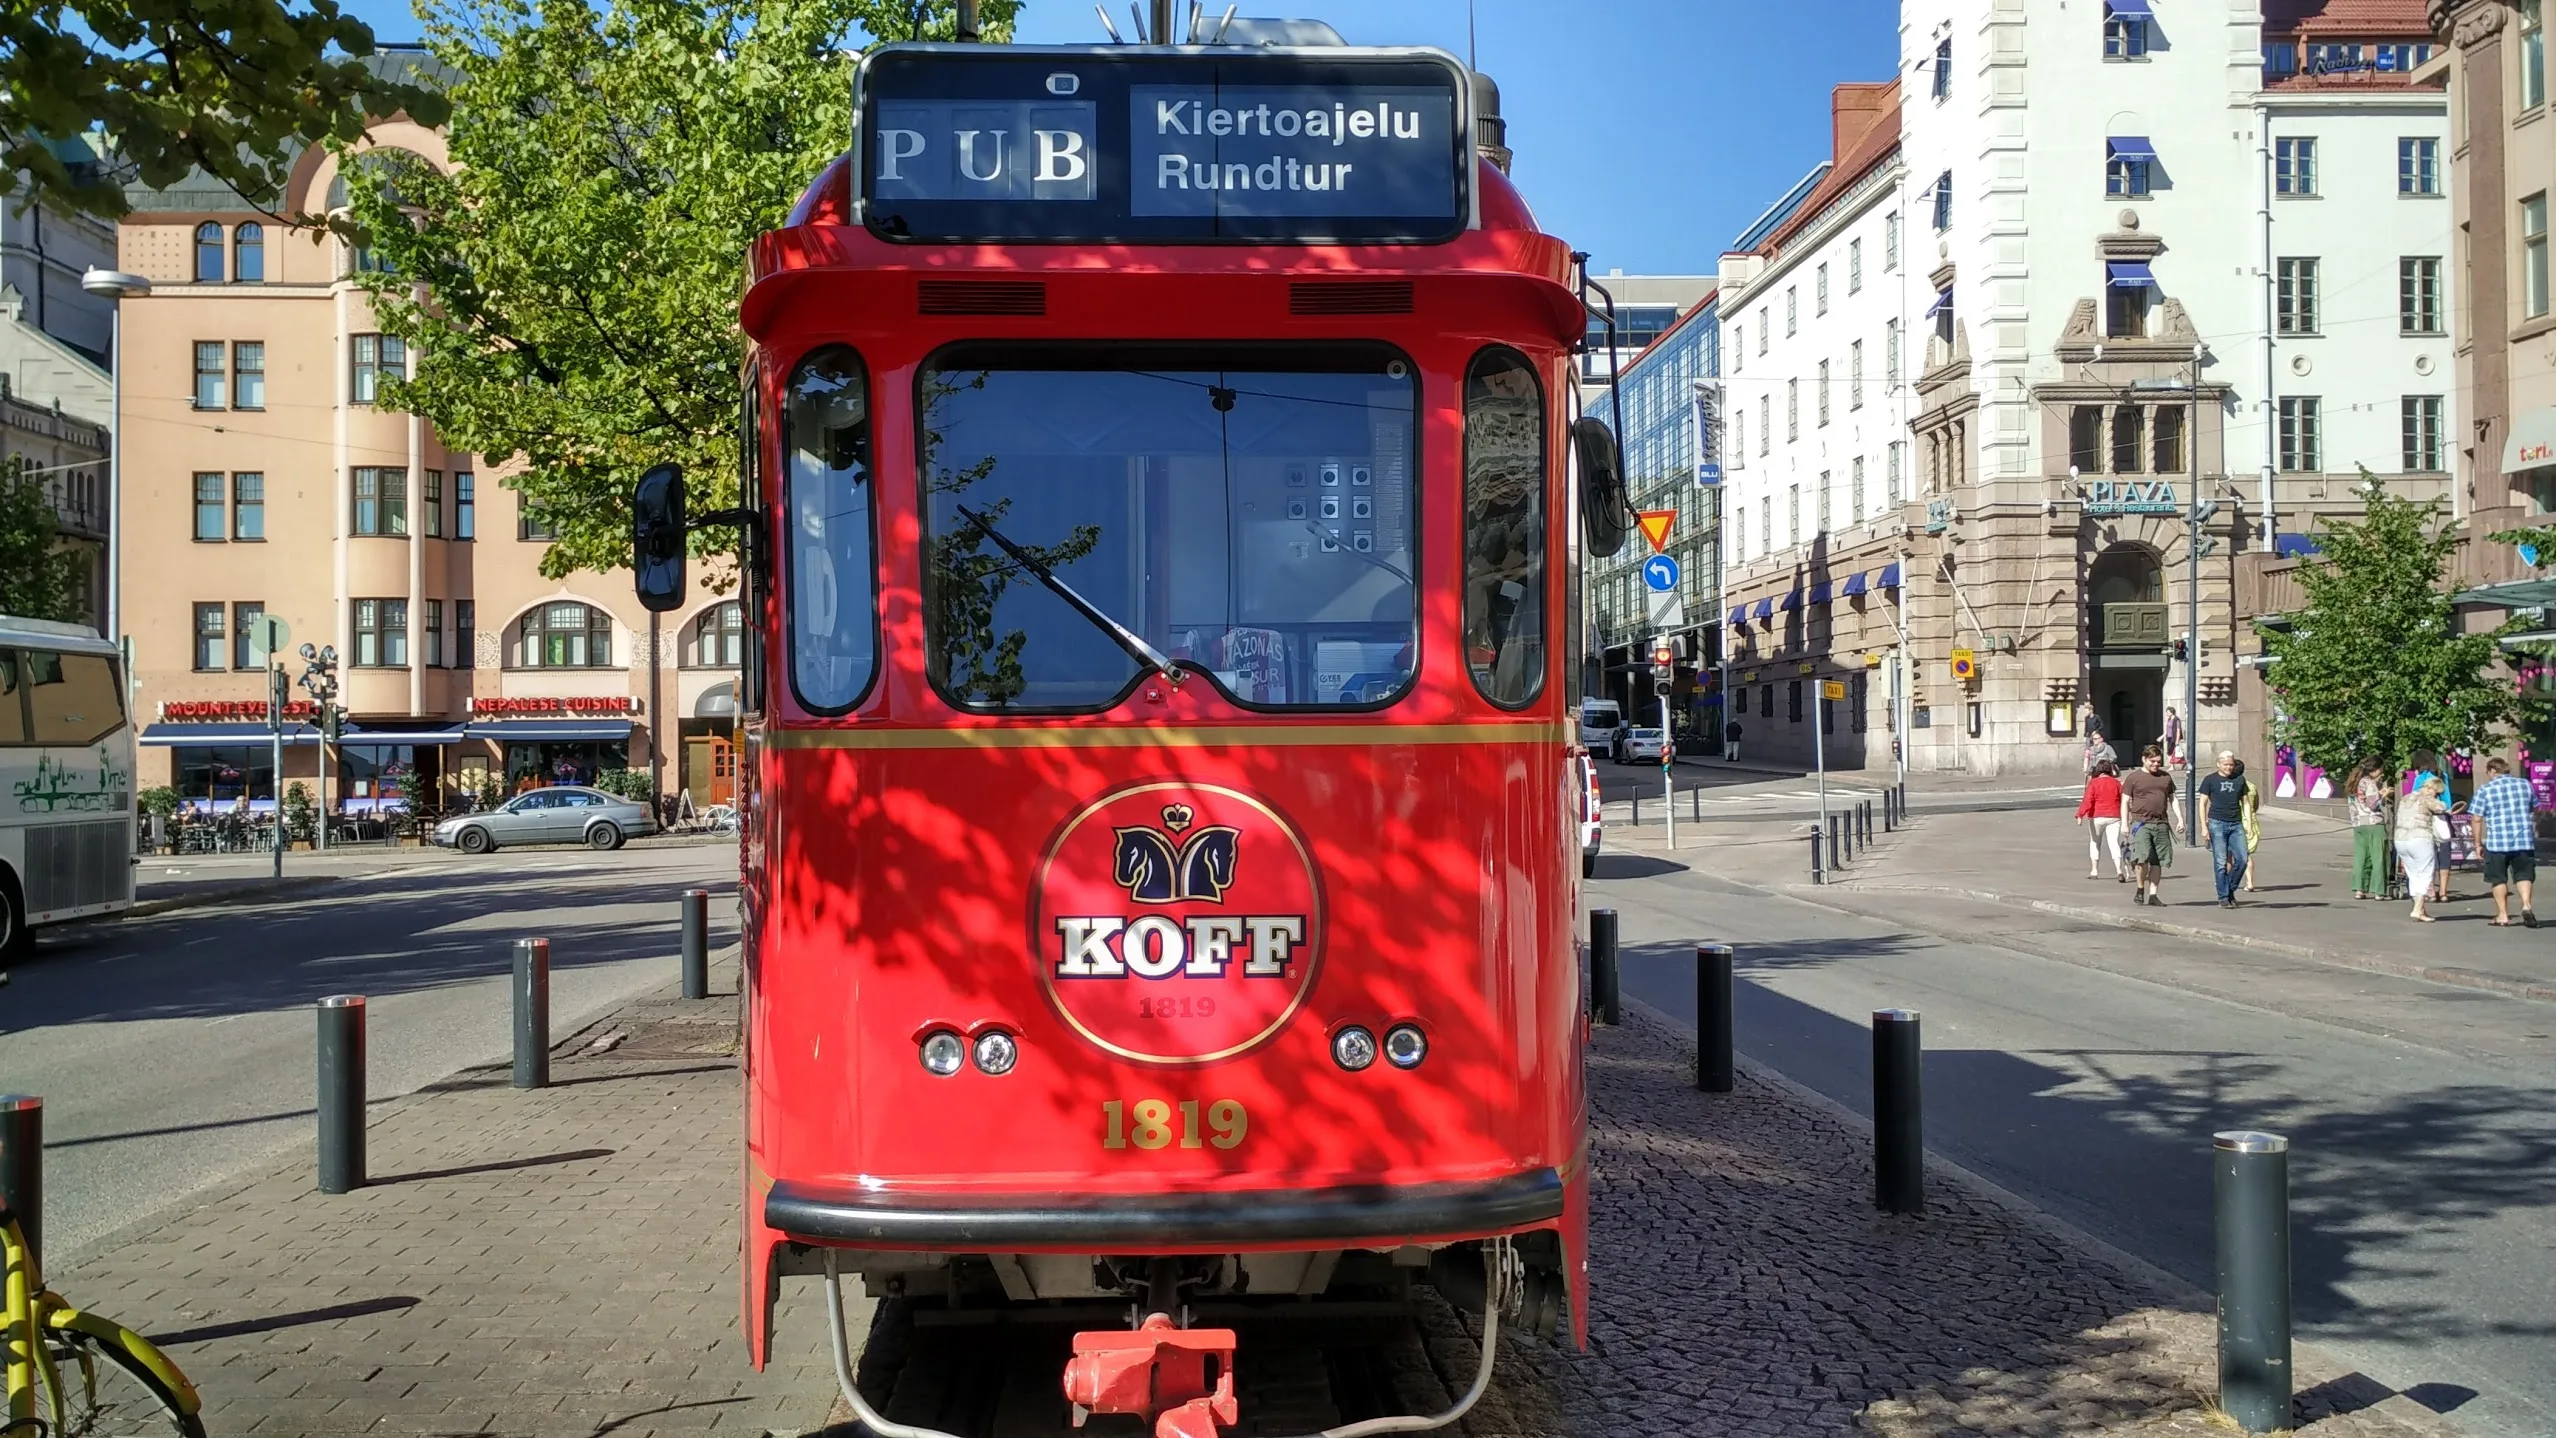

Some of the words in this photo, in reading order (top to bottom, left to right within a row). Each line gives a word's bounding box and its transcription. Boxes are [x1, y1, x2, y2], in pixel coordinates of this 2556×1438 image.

[1157, 100, 1420, 146] Kiertoajelu
[1157, 154, 1353, 192] Rundtur
[2093, 480, 2176, 502] PLAZA
[2089, 503, 2112, 512] Hotel
[2123, 503, 2175, 512] Restaurants
[1253, 667, 1280, 684] SUR
[1828, 686, 1840, 695] TAXI
[168, 701, 232, 715] MOUNT
[475, 698, 558, 711] NEPALESE
[564, 697, 628, 710] CUISINE
[1055, 914, 1307, 980] KOFF
[1139, 996, 1216, 1019] 1819
[1103, 1098, 1248, 1149] 1819
